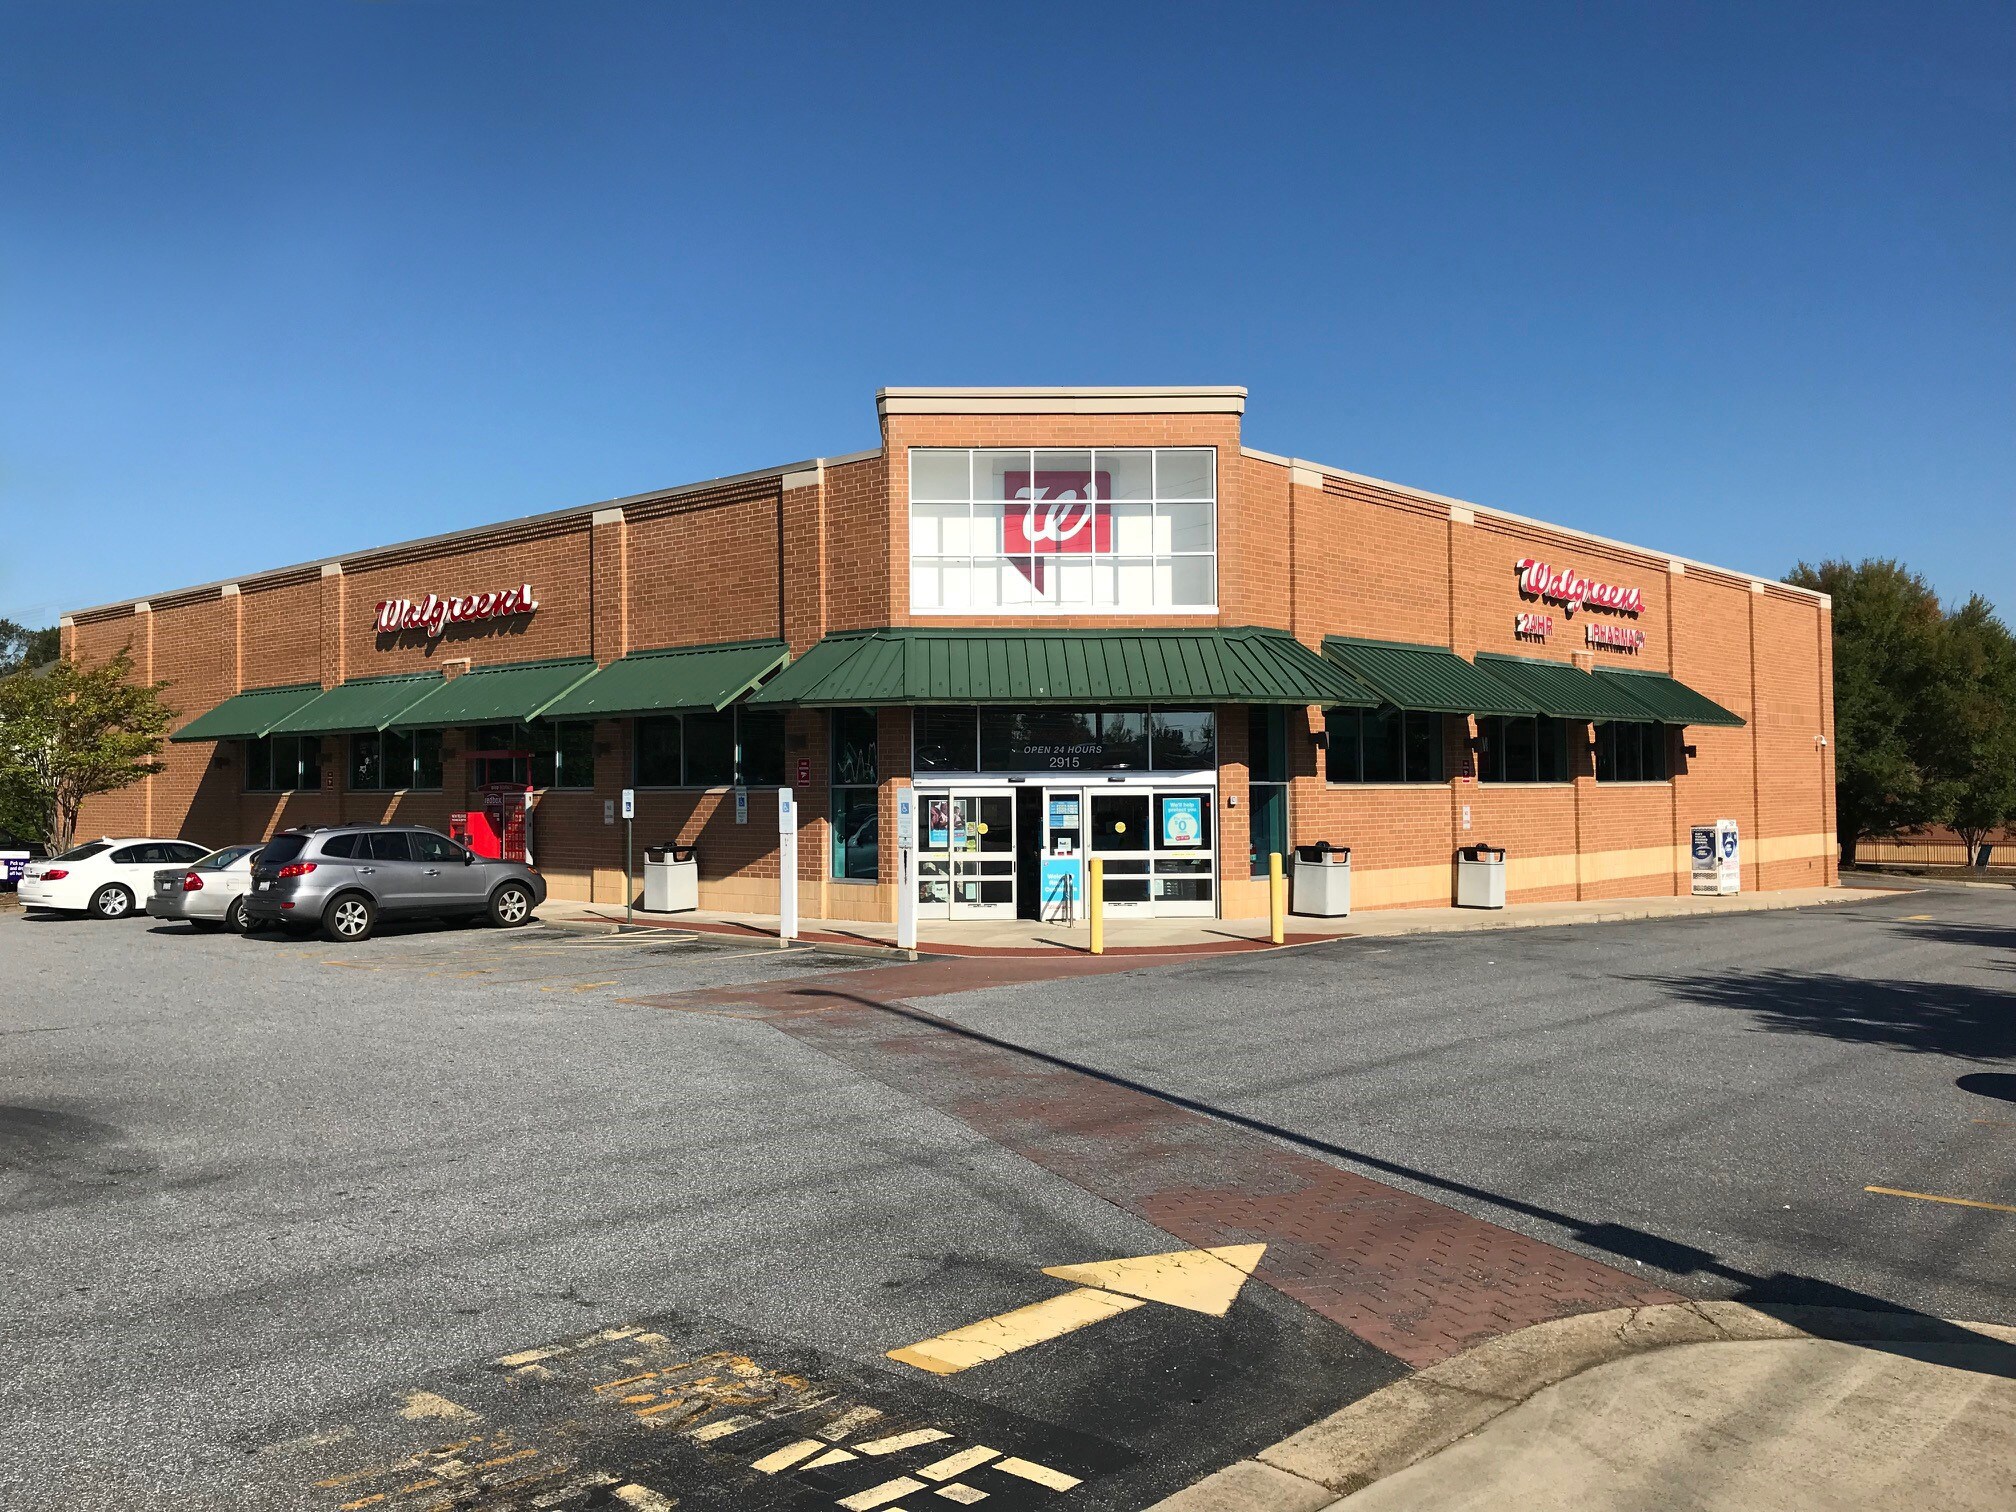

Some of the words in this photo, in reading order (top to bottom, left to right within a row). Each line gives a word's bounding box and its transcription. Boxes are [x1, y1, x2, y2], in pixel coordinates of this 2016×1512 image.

[1516, 558, 1646, 613] Walgreens
[374, 583, 539, 637] Walgreens
[1587, 623, 1647, 649] PHARMACY
[1023, 745, 1051, 754] OPEN
[1053, 745, 1065, 754] 24
[1067, 745, 1103, 754] HOURS
[1049, 757, 1080, 768] 2915
